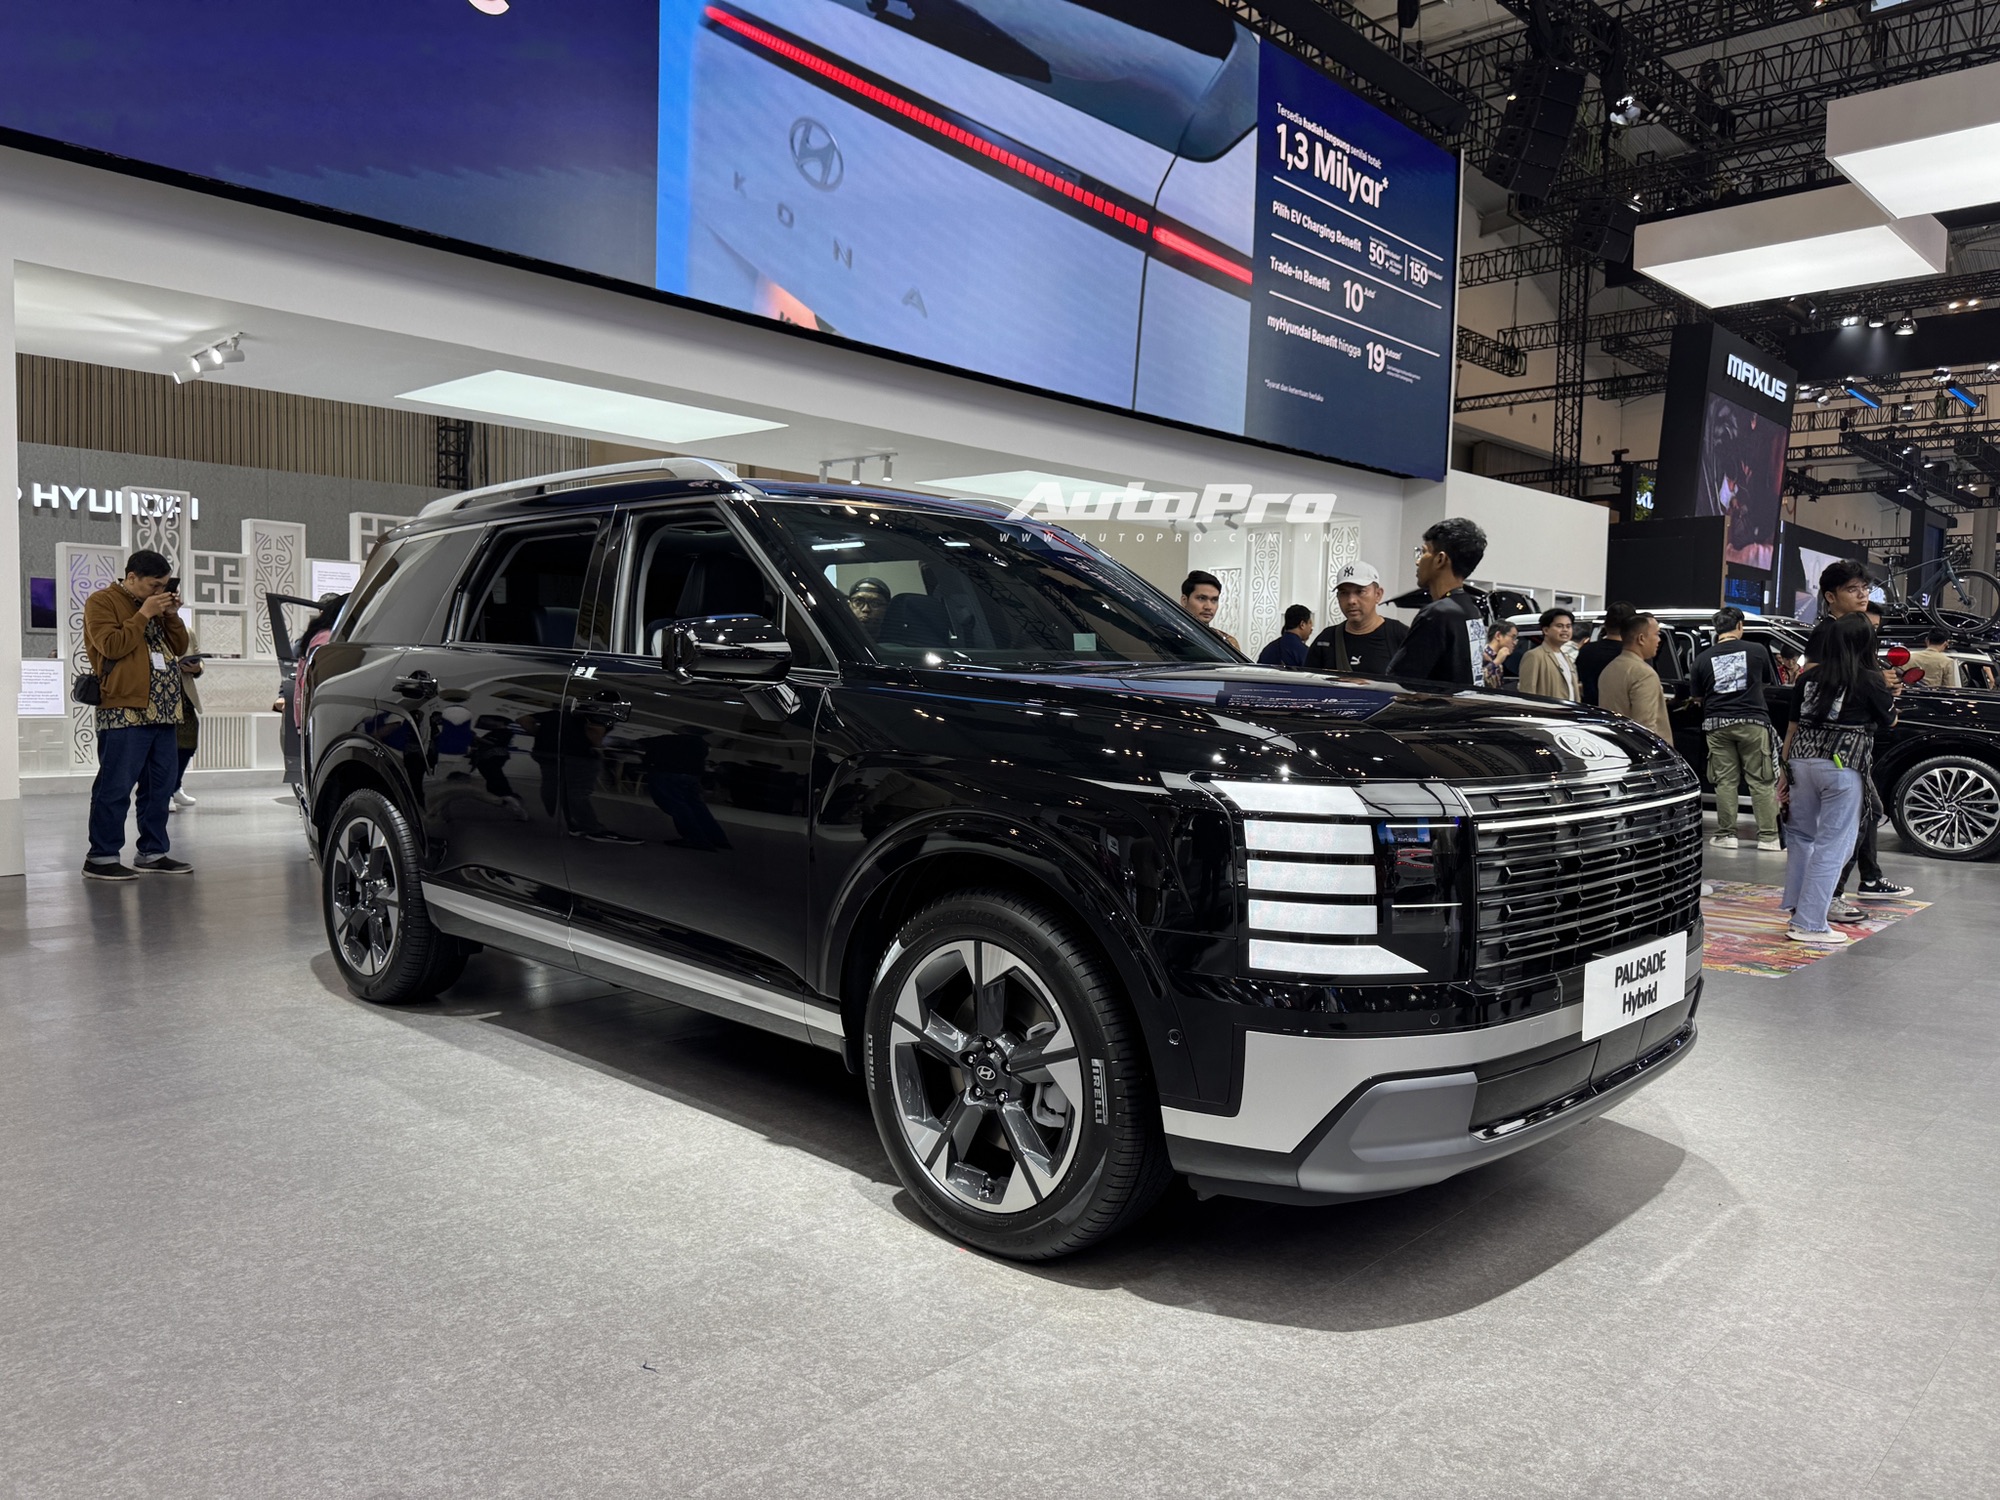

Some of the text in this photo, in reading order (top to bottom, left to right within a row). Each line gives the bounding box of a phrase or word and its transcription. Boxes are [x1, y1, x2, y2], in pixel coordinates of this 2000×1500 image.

[1277, 102, 1303, 126] Tersedia
[1276, 123, 1309, 171] 1,3
[1272, 200, 1290, 220] Pilih
[1290, 208, 1302, 225] EV
[1302, 214, 1336, 243] Charging
[1336, 230, 1362, 252] Benefit
[1368, 241, 1385, 265] 50
[1409, 261, 1428, 285] 150
[1269, 255, 1303, 281] Trade-in
[1303, 269, 1331, 291] Benefit
[1343, 280, 1364, 312] 10
[1266, 315, 1311, 340] myHyundai
[1311, 328, 1338, 349] Benefit
[1338, 339, 1361, 358] hingga
[1366, 341, 1385, 372] 19
[1727, 353, 1788, 403] MAXUS
[1615, 950, 1667, 988] PALISADE
[1622, 980, 1658, 1016] Hybrid
